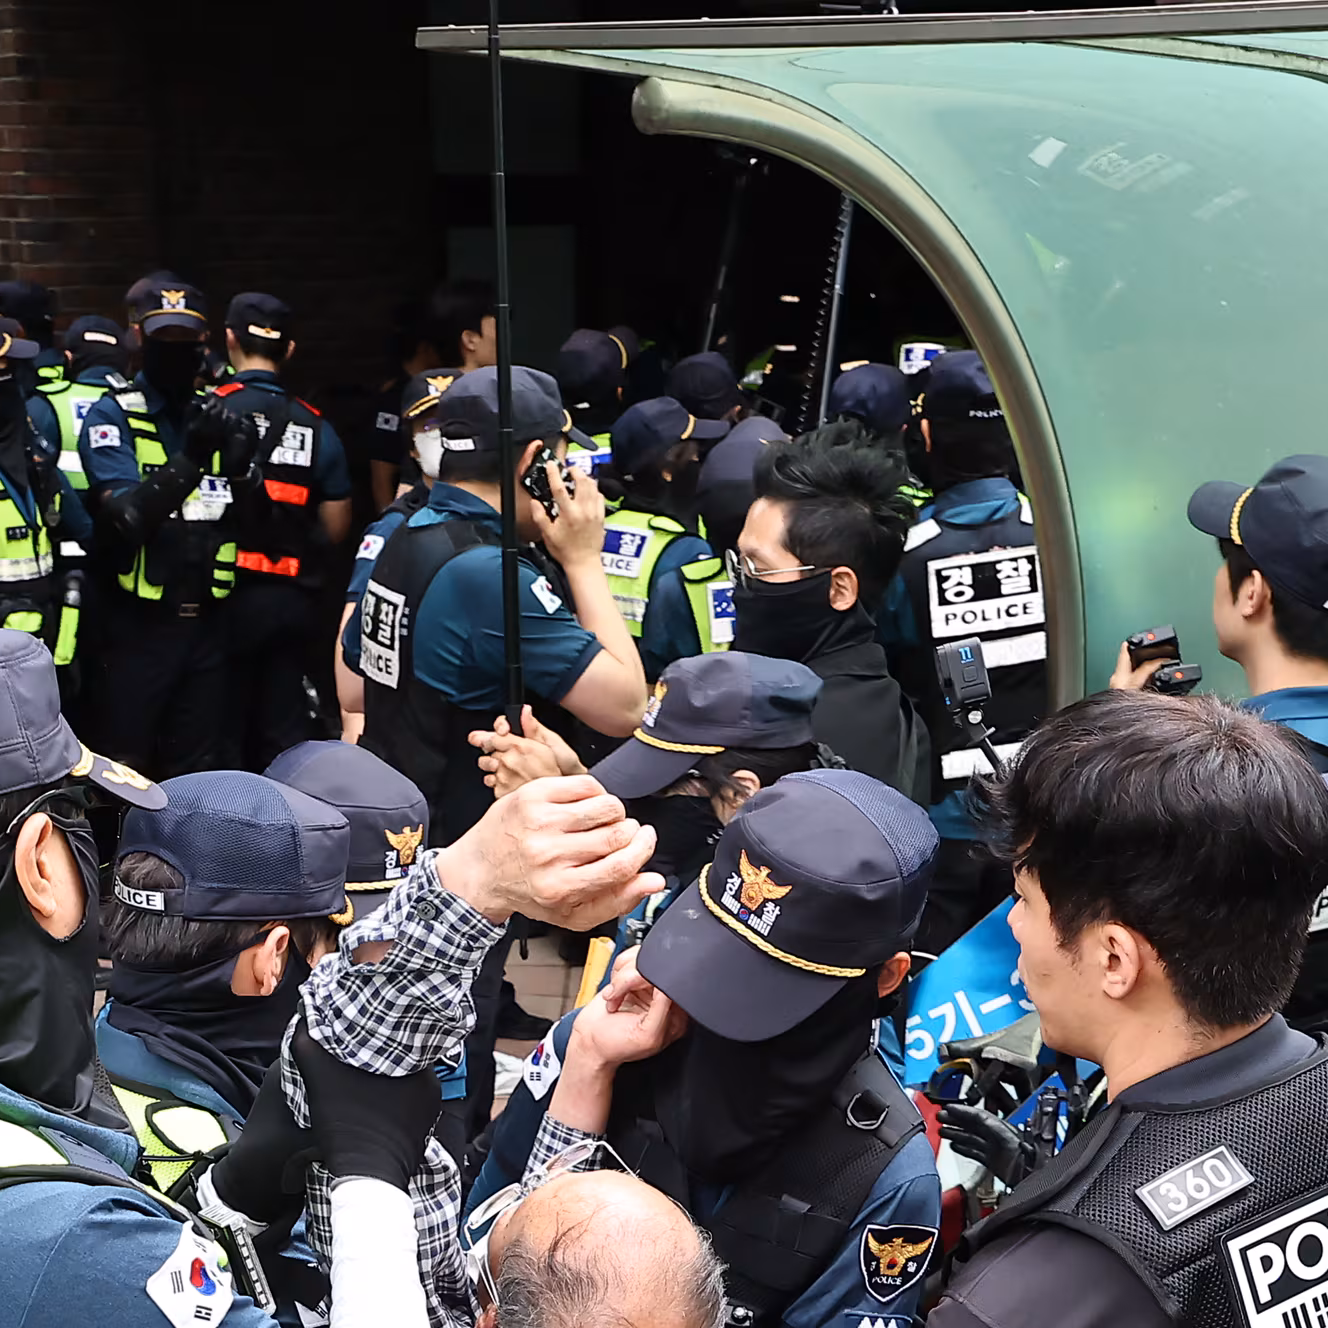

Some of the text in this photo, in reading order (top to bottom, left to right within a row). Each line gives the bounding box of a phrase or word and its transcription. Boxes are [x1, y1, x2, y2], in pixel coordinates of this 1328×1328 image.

[601, 556, 633, 571] LICE
[941, 557, 1032, 603] 경찰
[945, 601, 1035, 626] POLICE
[117, 883, 158, 908] OLICE
[1159, 1157, 1233, 1213] 360
[872, 1275, 904, 1286] POLICE
